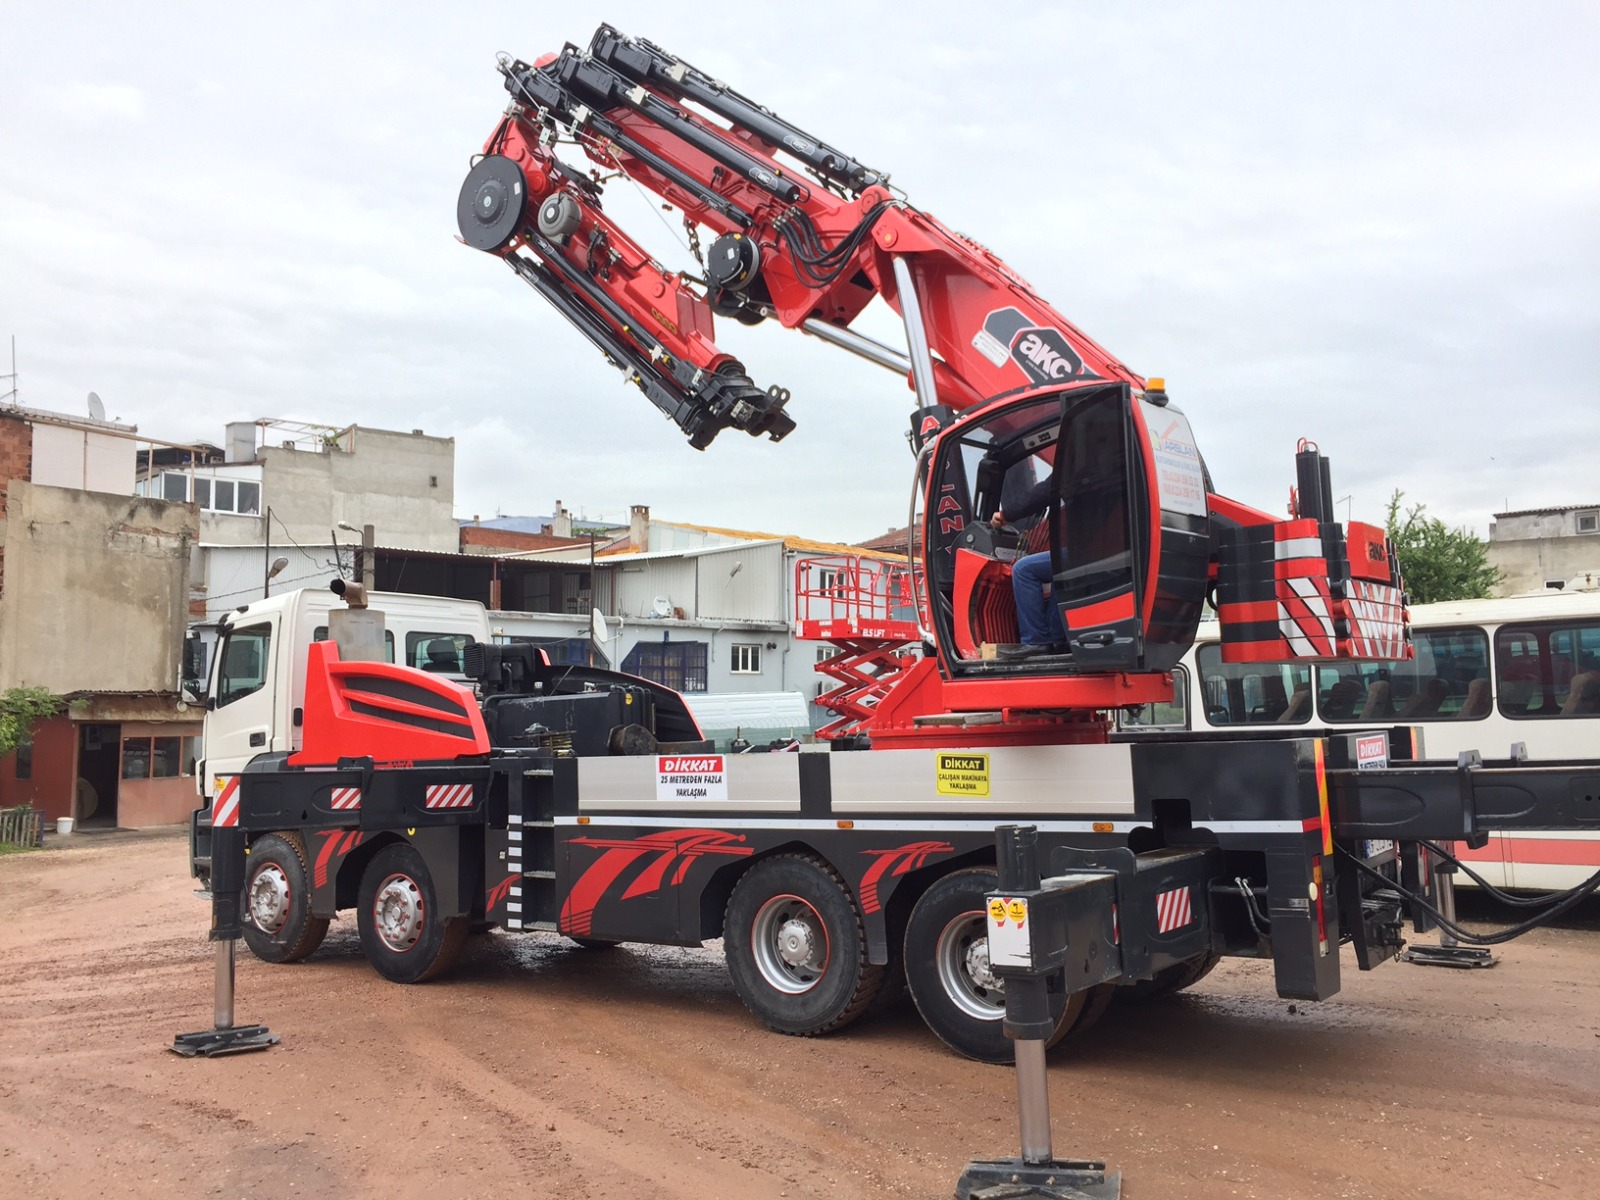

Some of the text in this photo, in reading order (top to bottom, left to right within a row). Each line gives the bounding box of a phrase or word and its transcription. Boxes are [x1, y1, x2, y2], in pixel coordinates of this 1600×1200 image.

[665, 758, 718, 772] DİKKAT
[945, 757, 981, 769] DİKKAT
[661, 775, 722, 784] 25 METREDEN FAZLA
[939, 773, 960, 781] ÇALIŞAN
[949, 782, 977, 790] YAKLAŞMA
[676, 788, 708, 799] YAKLAŞMA
